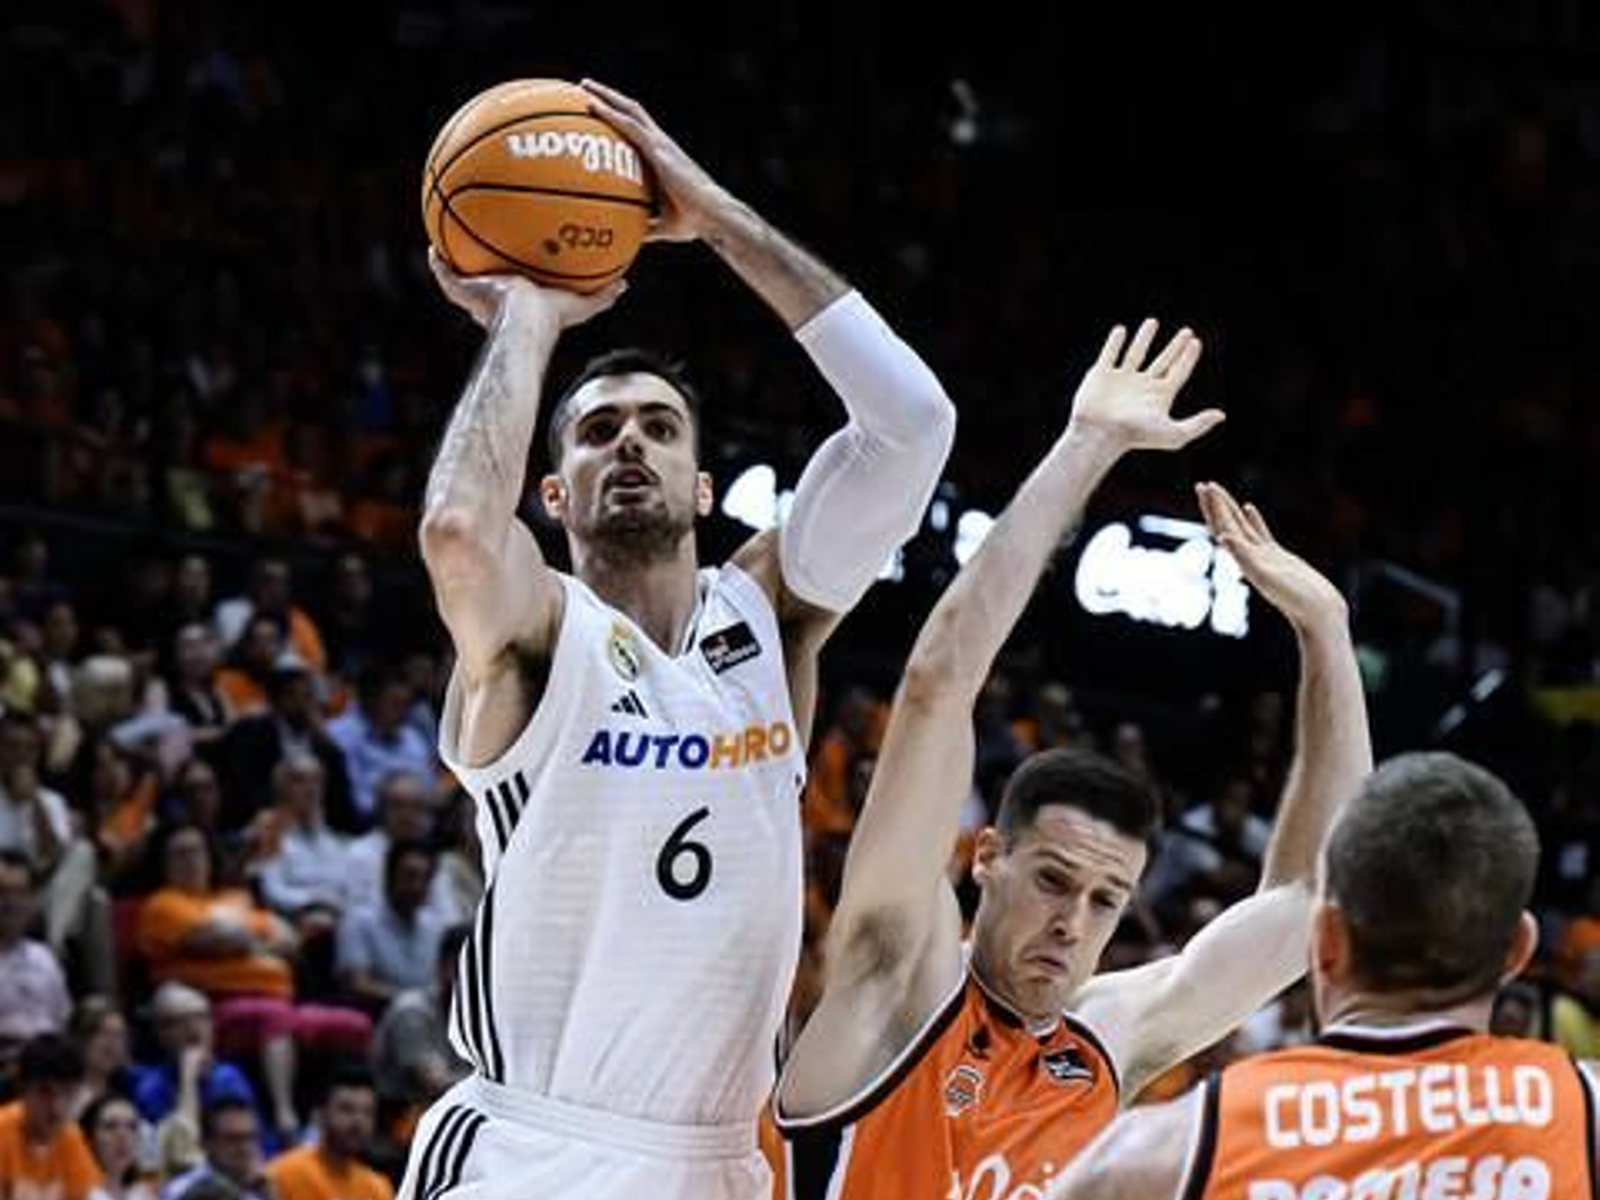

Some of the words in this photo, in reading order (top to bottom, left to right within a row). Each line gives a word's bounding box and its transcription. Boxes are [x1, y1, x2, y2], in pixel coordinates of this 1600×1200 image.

[507, 132, 642, 185] Wilson
[581, 722, 791, 769] AUTOHRO
[657, 806, 713, 901] 6
[1264, 1064, 1552, 1148] COSTELLO
